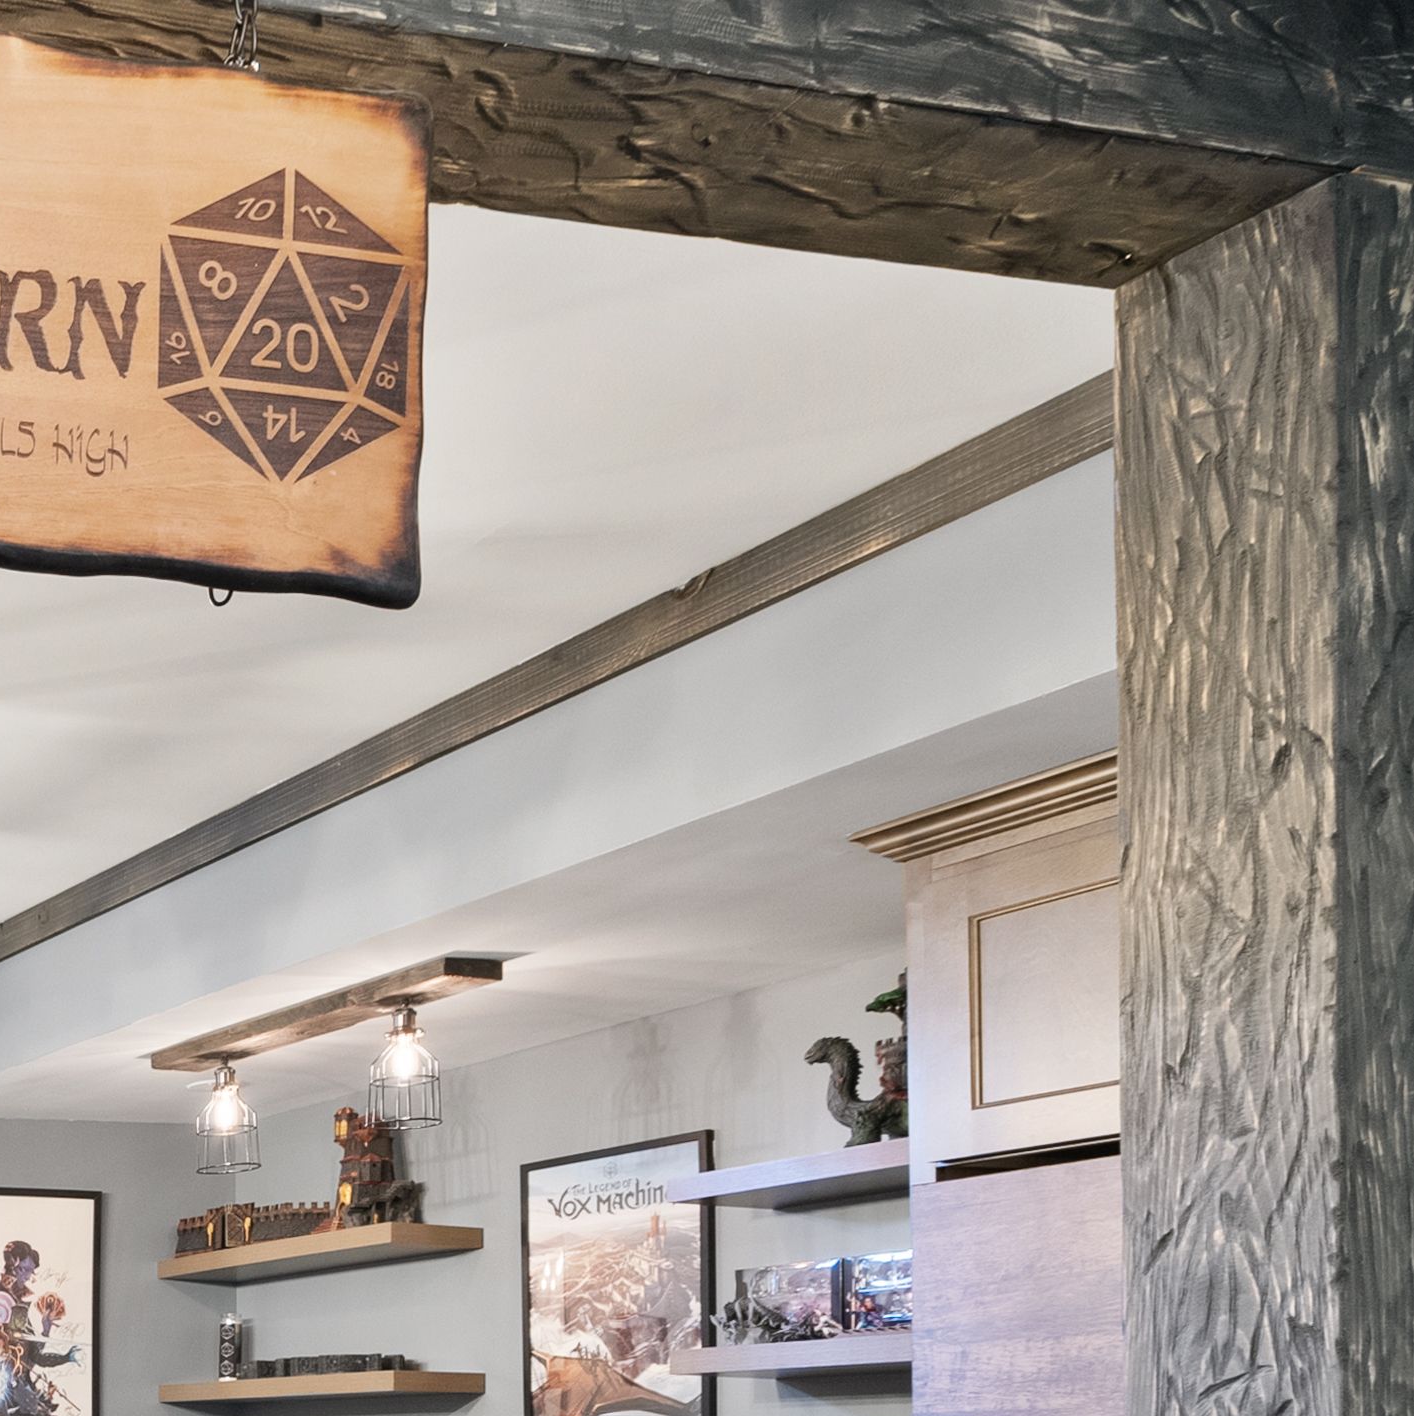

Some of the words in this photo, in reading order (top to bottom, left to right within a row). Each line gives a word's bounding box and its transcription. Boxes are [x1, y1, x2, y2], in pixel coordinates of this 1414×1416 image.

[235, 198, 276, 222] 10
[299, 204, 348, 234] 12
[198, 260, 238, 300] 8
[329, 284, 370, 323] 2
[250, 318, 319, 373] 20
[375, 361, 399, 390] 18
[262, 405, 306, 443] 14
[340, 427, 362, 445] 4
[52, 423, 129, 477] HIGH
[597, 1178, 667, 1215] Machin
